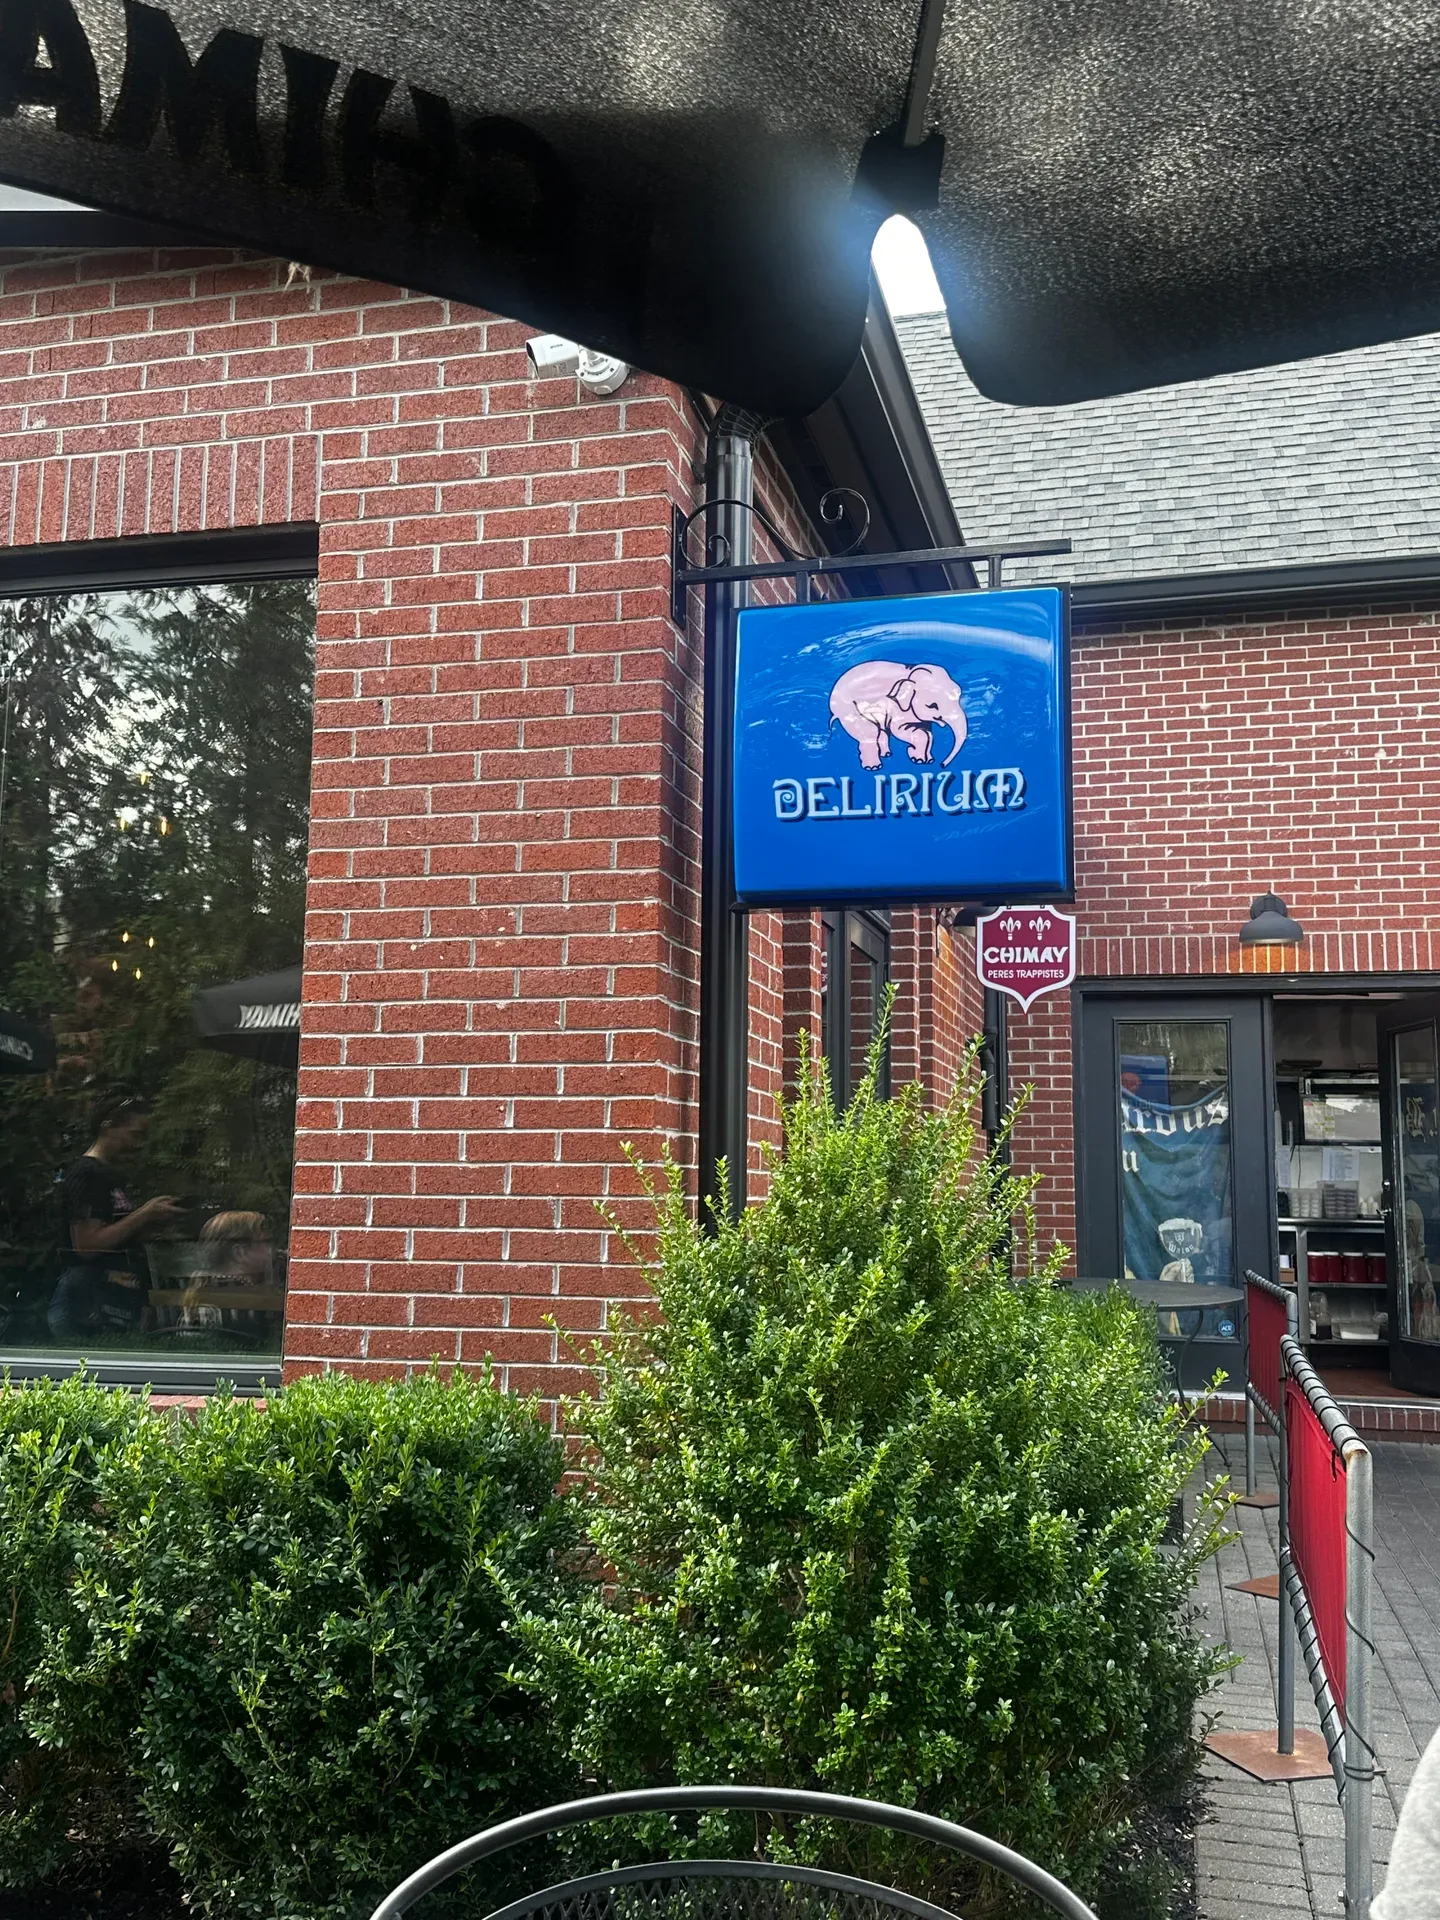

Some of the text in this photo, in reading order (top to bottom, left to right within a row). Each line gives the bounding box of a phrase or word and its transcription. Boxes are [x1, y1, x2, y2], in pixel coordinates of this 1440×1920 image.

[772, 767, 1027, 820] DELIRIUM
[983, 946, 1069, 964] CHIMAY
[987, 968, 1065, 979] PERES TRAPPISTES
